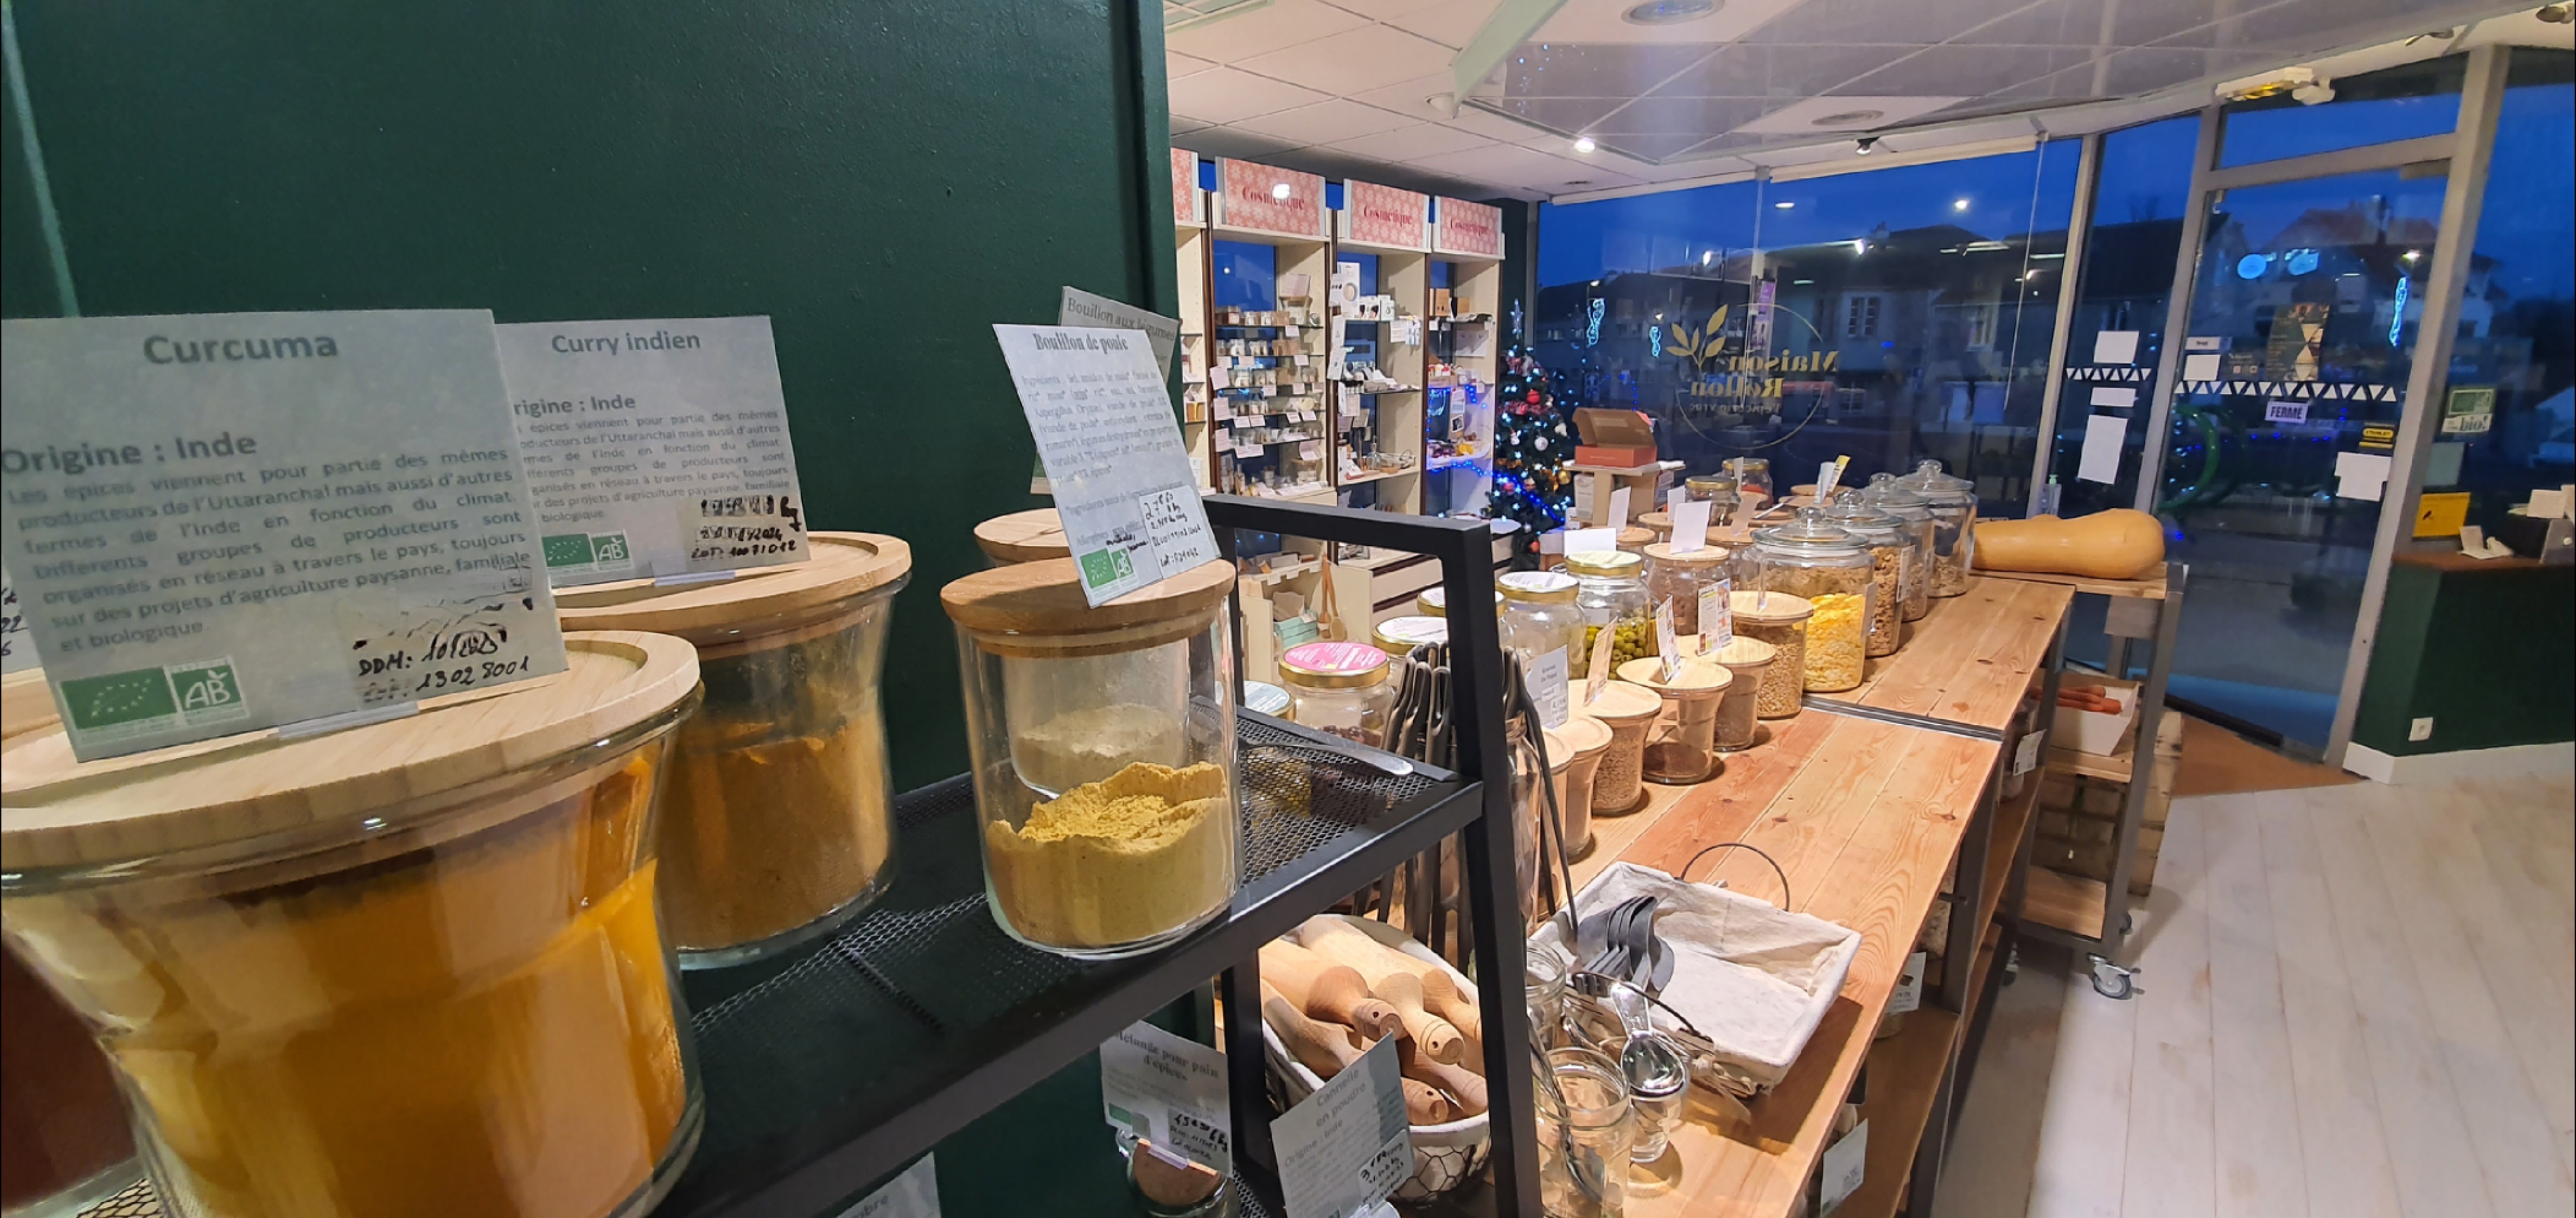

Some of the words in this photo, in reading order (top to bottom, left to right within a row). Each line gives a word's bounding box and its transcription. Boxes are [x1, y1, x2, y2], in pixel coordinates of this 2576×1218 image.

[1363, 205, 1413, 226] Cosmétique
[1067, 297, 1114, 323] Bouillon
[1114, 315, 1136, 329] aux
[143, 333, 339, 366] Curcuma
[551, 333, 619, 356] Curry
[625, 331, 702, 352] indien
[1033, 332, 1085, 351] Bouillon
[1086, 333, 1099, 350] de
[1100, 334, 1129, 355] poule
[513, 399, 572, 418] rigine
[590, 394, 636, 411] Inde
[2269, 405, 2303, 420] FERMÉ
[519, 435, 581, 450] oducteurs
[583, 433, 599, 445] de
[600, 427, 676, 443] l'Uttaranchal
[678, 427, 705, 438] mais
[707, 424, 735, 437] aussi
[736, 423, 782, 435] d'autres
[529, 419, 570, 435] épices
[576, 417, 629, 431] viennent
[636, 415, 664, 428] pour
[671, 412, 705, 426] partie
[711, 411, 732, 422] des
[738, 408, 779, 421] mêmes
[1, 441, 143, 475] Origine
[175, 431, 257, 459] Inde
[522, 454, 553, 464] rmes
[565, 451, 580, 461] de
[637, 446, 653, 456] en
[664, 442, 710, 455] fonction
[721, 441, 736, 451] du
[526, 467, 575, 479] fférents
[589, 461, 637, 476] groupes
[652, 459, 667, 470] de
[681, 455, 749, 469] producteurs
[762, 451, 785, 462] sont
[150, 469, 247, 492] viennent
[260, 464, 309, 484] pour
[322, 456, 382, 478] partie
[394, 453, 428, 469] des
[441, 447, 509, 465] mêmes
[531, 480, 576, 497] ganisés
[580, 480, 596, 490] en
[599, 474, 640, 488] réseau
[643, 475, 651, 485] à
[654, 471, 694, 484] travers
[697, 470, 707, 480] le
[712, 470, 740, 484] pays,
[742, 465, 789, 479] toujours
[17, 504, 158, 532] producteurs
[163, 499, 190, 516] de
[193, 484, 330, 512] l'Uttaranchal
[335, 482, 382, 498] mais
[386, 475, 434, 493] aussi
[438, 468, 513, 488] d'autres
[544, 497, 565, 508] des
[567, 493, 610, 508] projets
[612, 487, 686, 504] d'agriculture
[744, 479, 790, 491] familiale
[129, 527, 158, 545] de
[263, 515, 290, 530] en
[310, 503, 393, 524] fonction
[413, 498, 437, 513] du
[176, 541, 263, 568] groupes
[290, 534, 316, 549] de
[343, 518, 460, 546] producteurs
[482, 509, 522, 527] sont
[599, 542, 624, 560] AB
[42, 576, 152, 606] organisés
[158, 575, 187, 590] en
[193, 562, 266, 586] réseau
[273, 561, 286, 575] à
[292, 550, 364, 573] travers
[370, 546, 389, 561] le
[396, 544, 445, 563] pays,
[450, 531, 526, 553] toujours
[50, 612, 86, 629] sur
[92, 605, 132, 623] des
[138, 592, 214, 621] projets
[219, 574, 349, 607] d'agriculture
[355, 563, 452, 589] paysanne,
[455, 551, 532, 573] familiale
[59, 636, 84, 653] et
[358, 650, 413, 676] DDM:
[184, 678, 231, 709] AB
[1162, 1049, 1190, 1066] pour
[1191, 1061, 1219, 1079] pain
[1317, 1068, 1360, 1107] Cannelle
[1315, 1112, 1329, 1127] en
[1331, 1082, 1366, 1116] poudre
[1285, 1139, 1318, 1168] Origine
[1324, 1120, 1343, 1140] Inde
